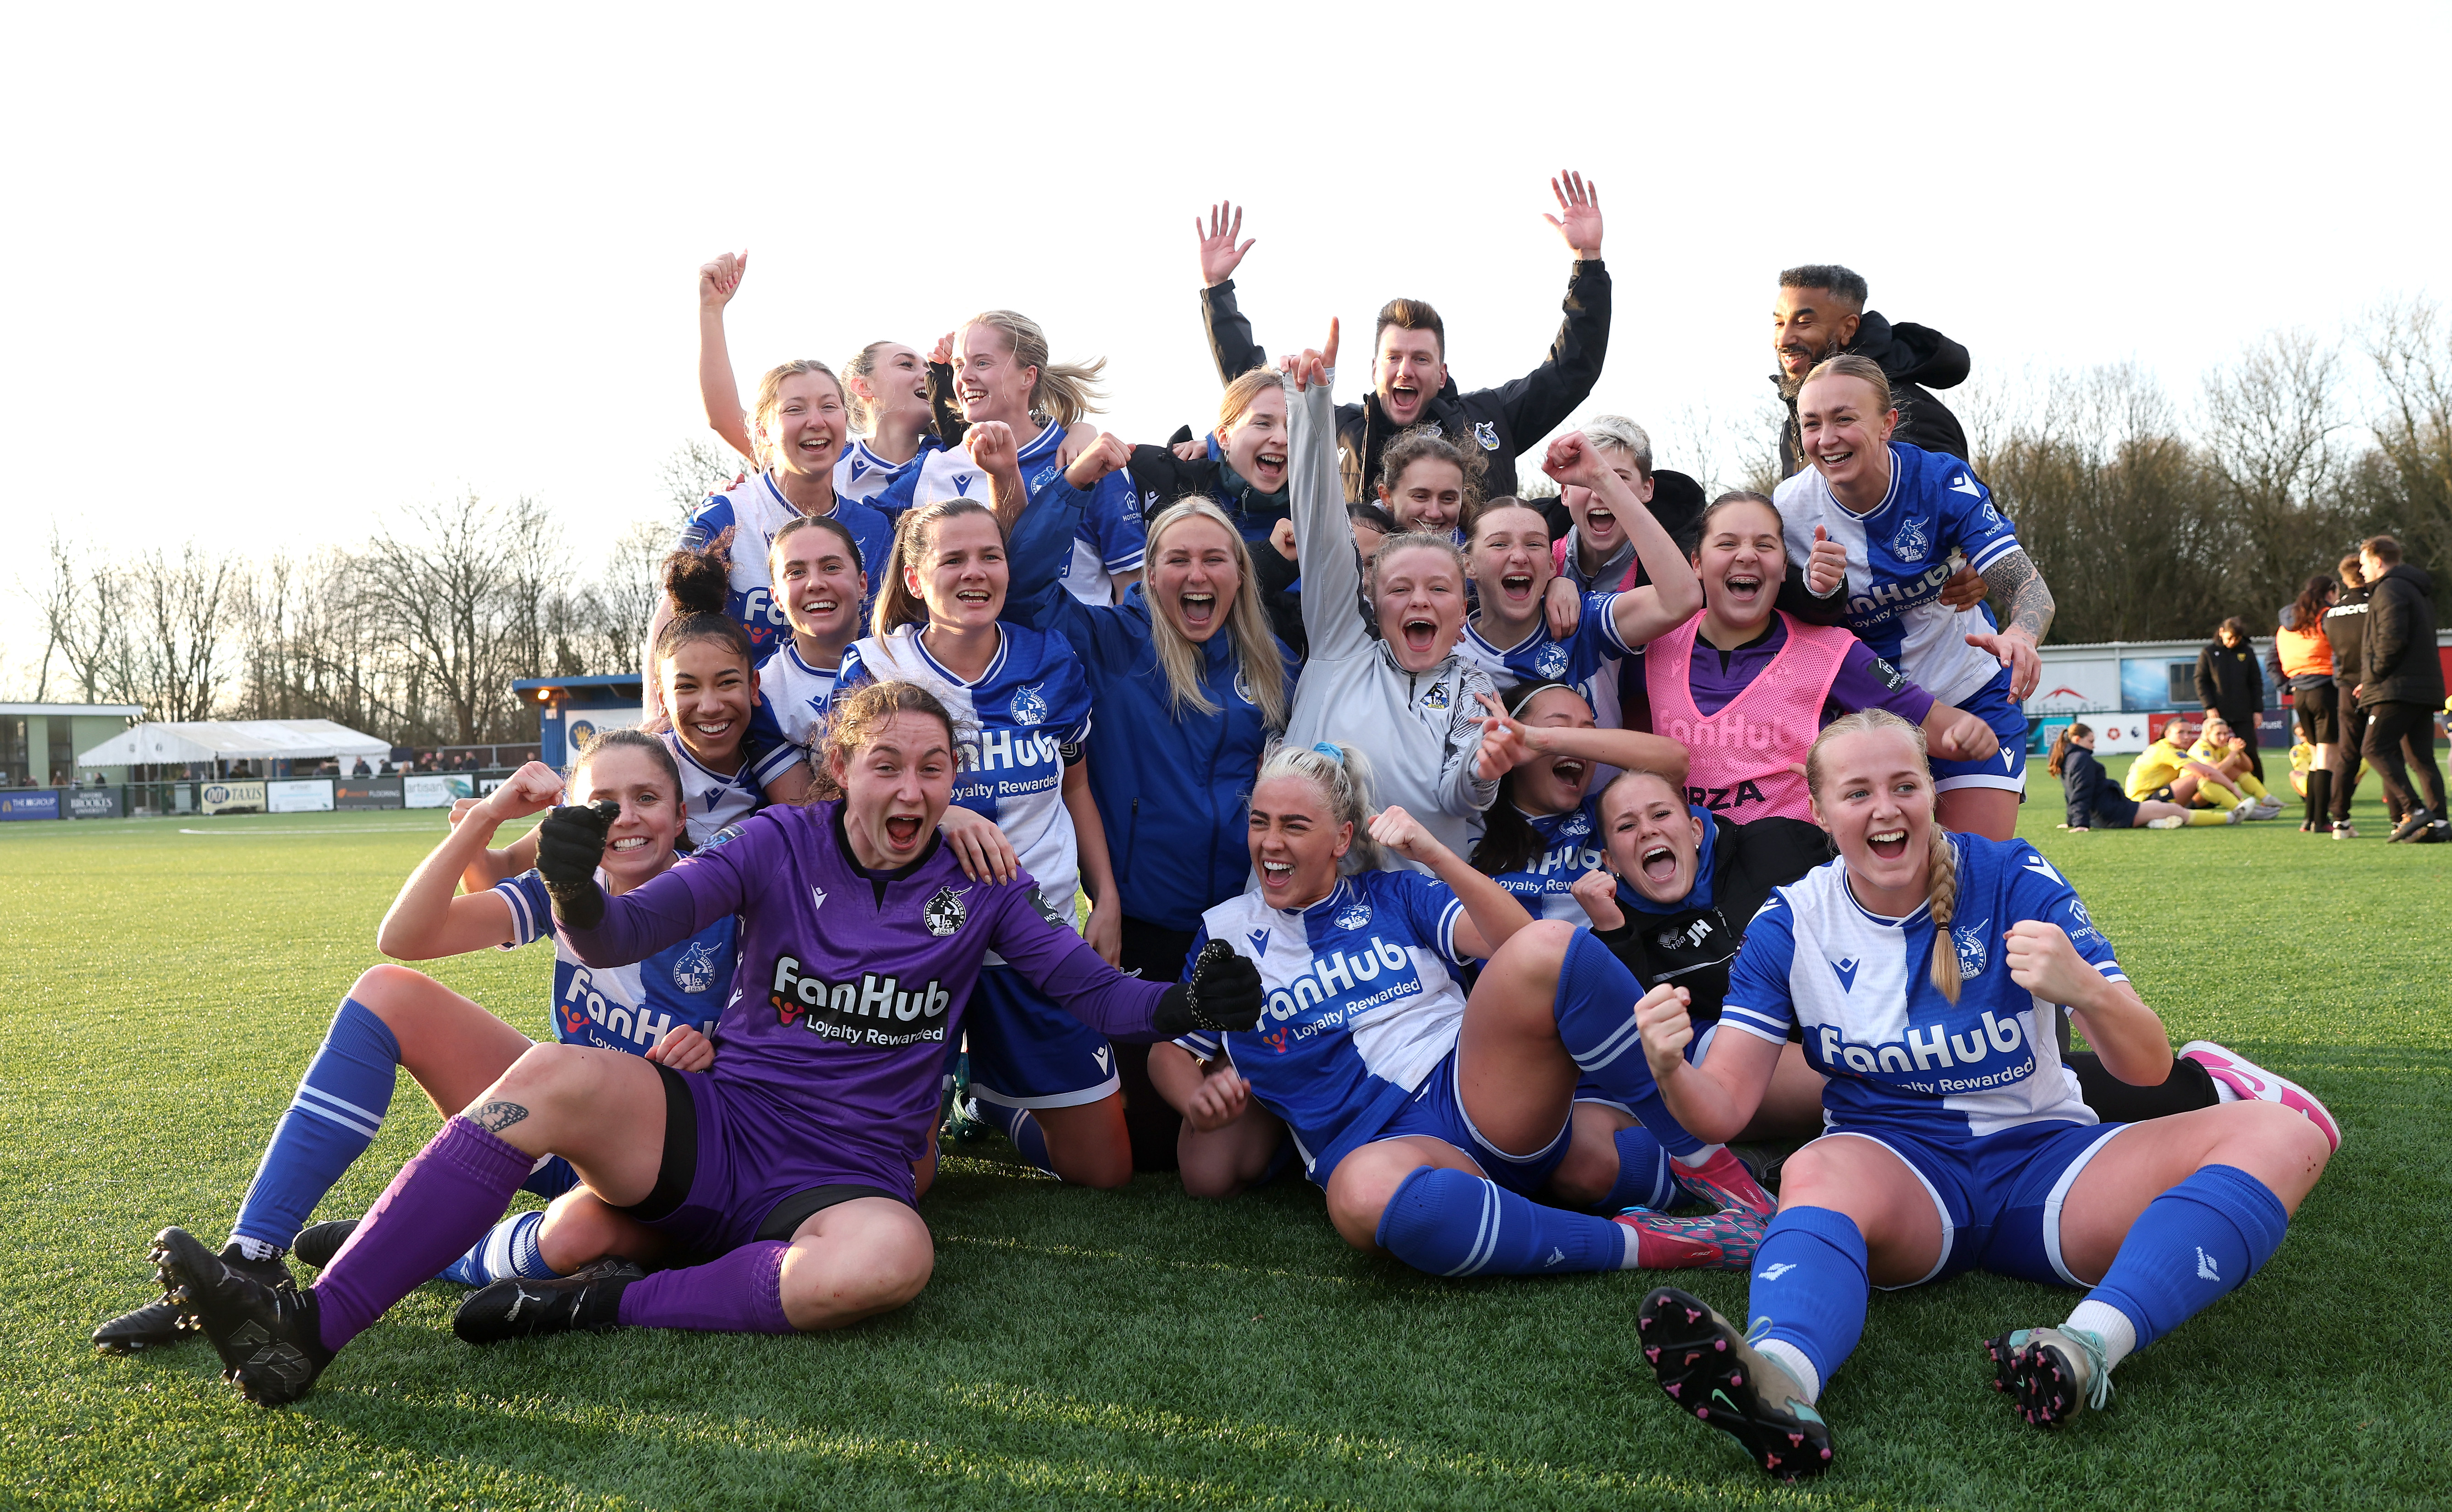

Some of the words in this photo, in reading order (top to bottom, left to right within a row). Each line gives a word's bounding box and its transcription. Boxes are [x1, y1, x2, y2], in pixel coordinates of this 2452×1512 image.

[1913, 531, 1926, 546] ROVERS
[1843, 564, 1949, 615] nHub
[1536, 657, 1547, 676] BRISTOL
[1551, 646, 1566, 659] ROVERS
[1237, 677, 1245, 696] BRISTO
[1012, 700, 1022, 722] BRISTOL
[1030, 694, 1046, 711] ROVERS
[956, 730, 1054, 773] nHub
[207, 787, 227, 803] 001
[231, 788, 262, 801] TAXIS
[368, 789, 400, 798] FLOORING
[407, 781, 444, 794] artisan
[951, 783, 994, 801] oyalty
[998, 772, 1058, 795] Rewarded
[1682, 780, 1766, 812] RZA
[926, 901, 934, 927] BRISTOL
[951, 897, 964, 919] ROVERS
[1687, 919, 1713, 948] JH
[1966, 937, 1984, 957] ROVERS
[676, 961, 684, 985] BRISTOL
[700, 956, 713, 977] ROVERS
[1961, 971, 1976, 979] 1883
[774, 956, 950, 1022] FanHub
[565, 968, 672, 1047] FanH
[1292, 1009, 1343, 1041] Loyalty
[1346, 978, 1421, 1015] Rewarded
[806, 1014, 862, 1044] Loyalty
[866, 1027, 944, 1045] Rewarded
[1820, 1010, 2022, 1073] FanHub
[1939, 1056, 2034, 1092] Rewarded
